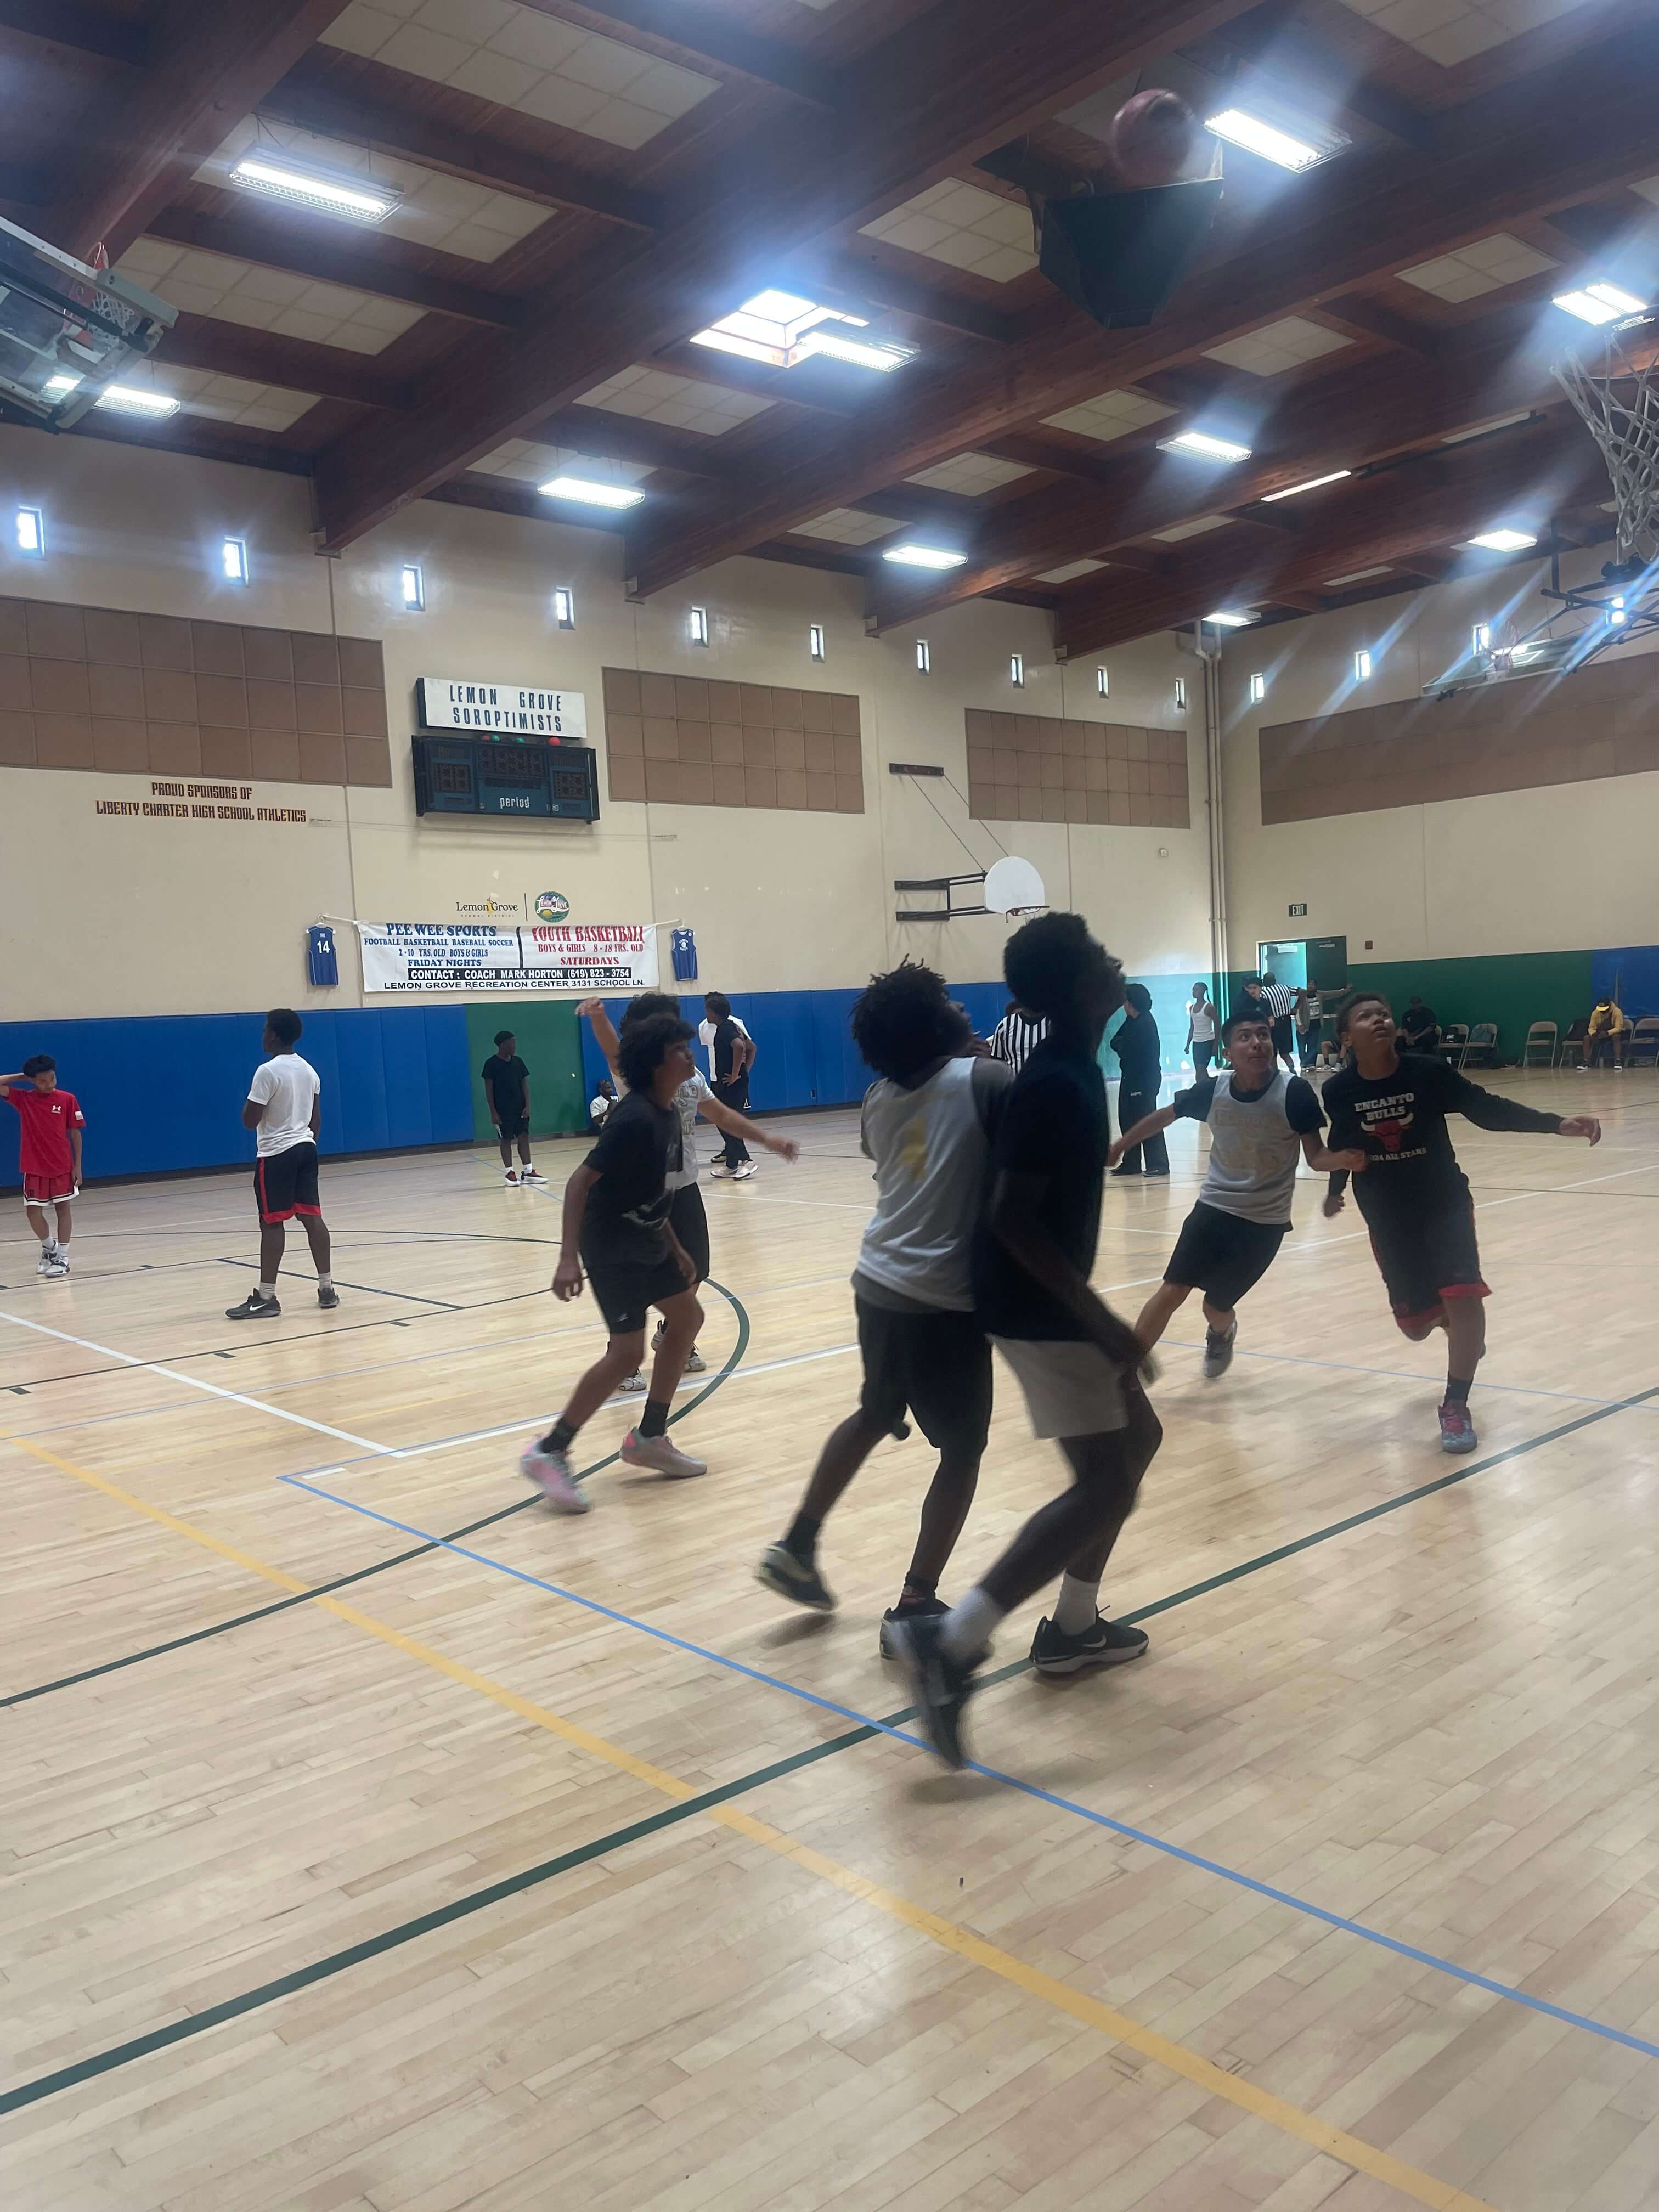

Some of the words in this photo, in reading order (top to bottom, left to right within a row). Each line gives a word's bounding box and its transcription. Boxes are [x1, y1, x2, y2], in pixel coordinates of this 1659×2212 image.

[450, 685, 497, 706] LEMON
[519, 692, 561, 712] GROVE
[453, 707, 562, 732] SOROPTIMISTS
[151, 782, 184, 797] PROUD
[188, 785, 238, 799] SPONSORS
[240, 787, 252, 800] OF
[500, 797, 530, 809] period
[97, 800, 140, 816] LIBERTY
[143, 803, 189, 817] CHARTER
[192, 805, 216, 819] HIGH
[218, 806, 255, 821] SCHOOL
[257, 808, 307, 822] ATHLETICS
[456, 901, 489, 911] Lemon
[491, 901, 518, 911] Grove
[1292, 905, 1304, 916] EXIT
[386, 923, 413, 935] PEE
[414, 924, 444, 936] WEE
[447, 925, 497, 937] SPORTS
[532, 926, 572, 941] YOUTH
[575, 926, 645, 942] BASKETBALL
[317, 940, 330, 953] 14
[433, 948, 445, 957] OLD
[450, 949, 465, 957] BOYS
[471, 949, 488, 957] GIRLS
[538, 943, 556, 952] BOYS
[558, 943, 564, 952] &
[566, 943, 586, 952] GIRLS
[631, 943, 644, 952] OLD
[560, 957, 619, 965] SATURDAYS
[464, 970, 495, 979] COACH
[500, 969, 526, 979] MARK
[528, 969, 563, 979] HORTON
[567, 969, 588, 979] (619)
[1354, 1092, 1414, 1112] ENCANTO
[1365, 1105, 1406, 1121] BULLS
